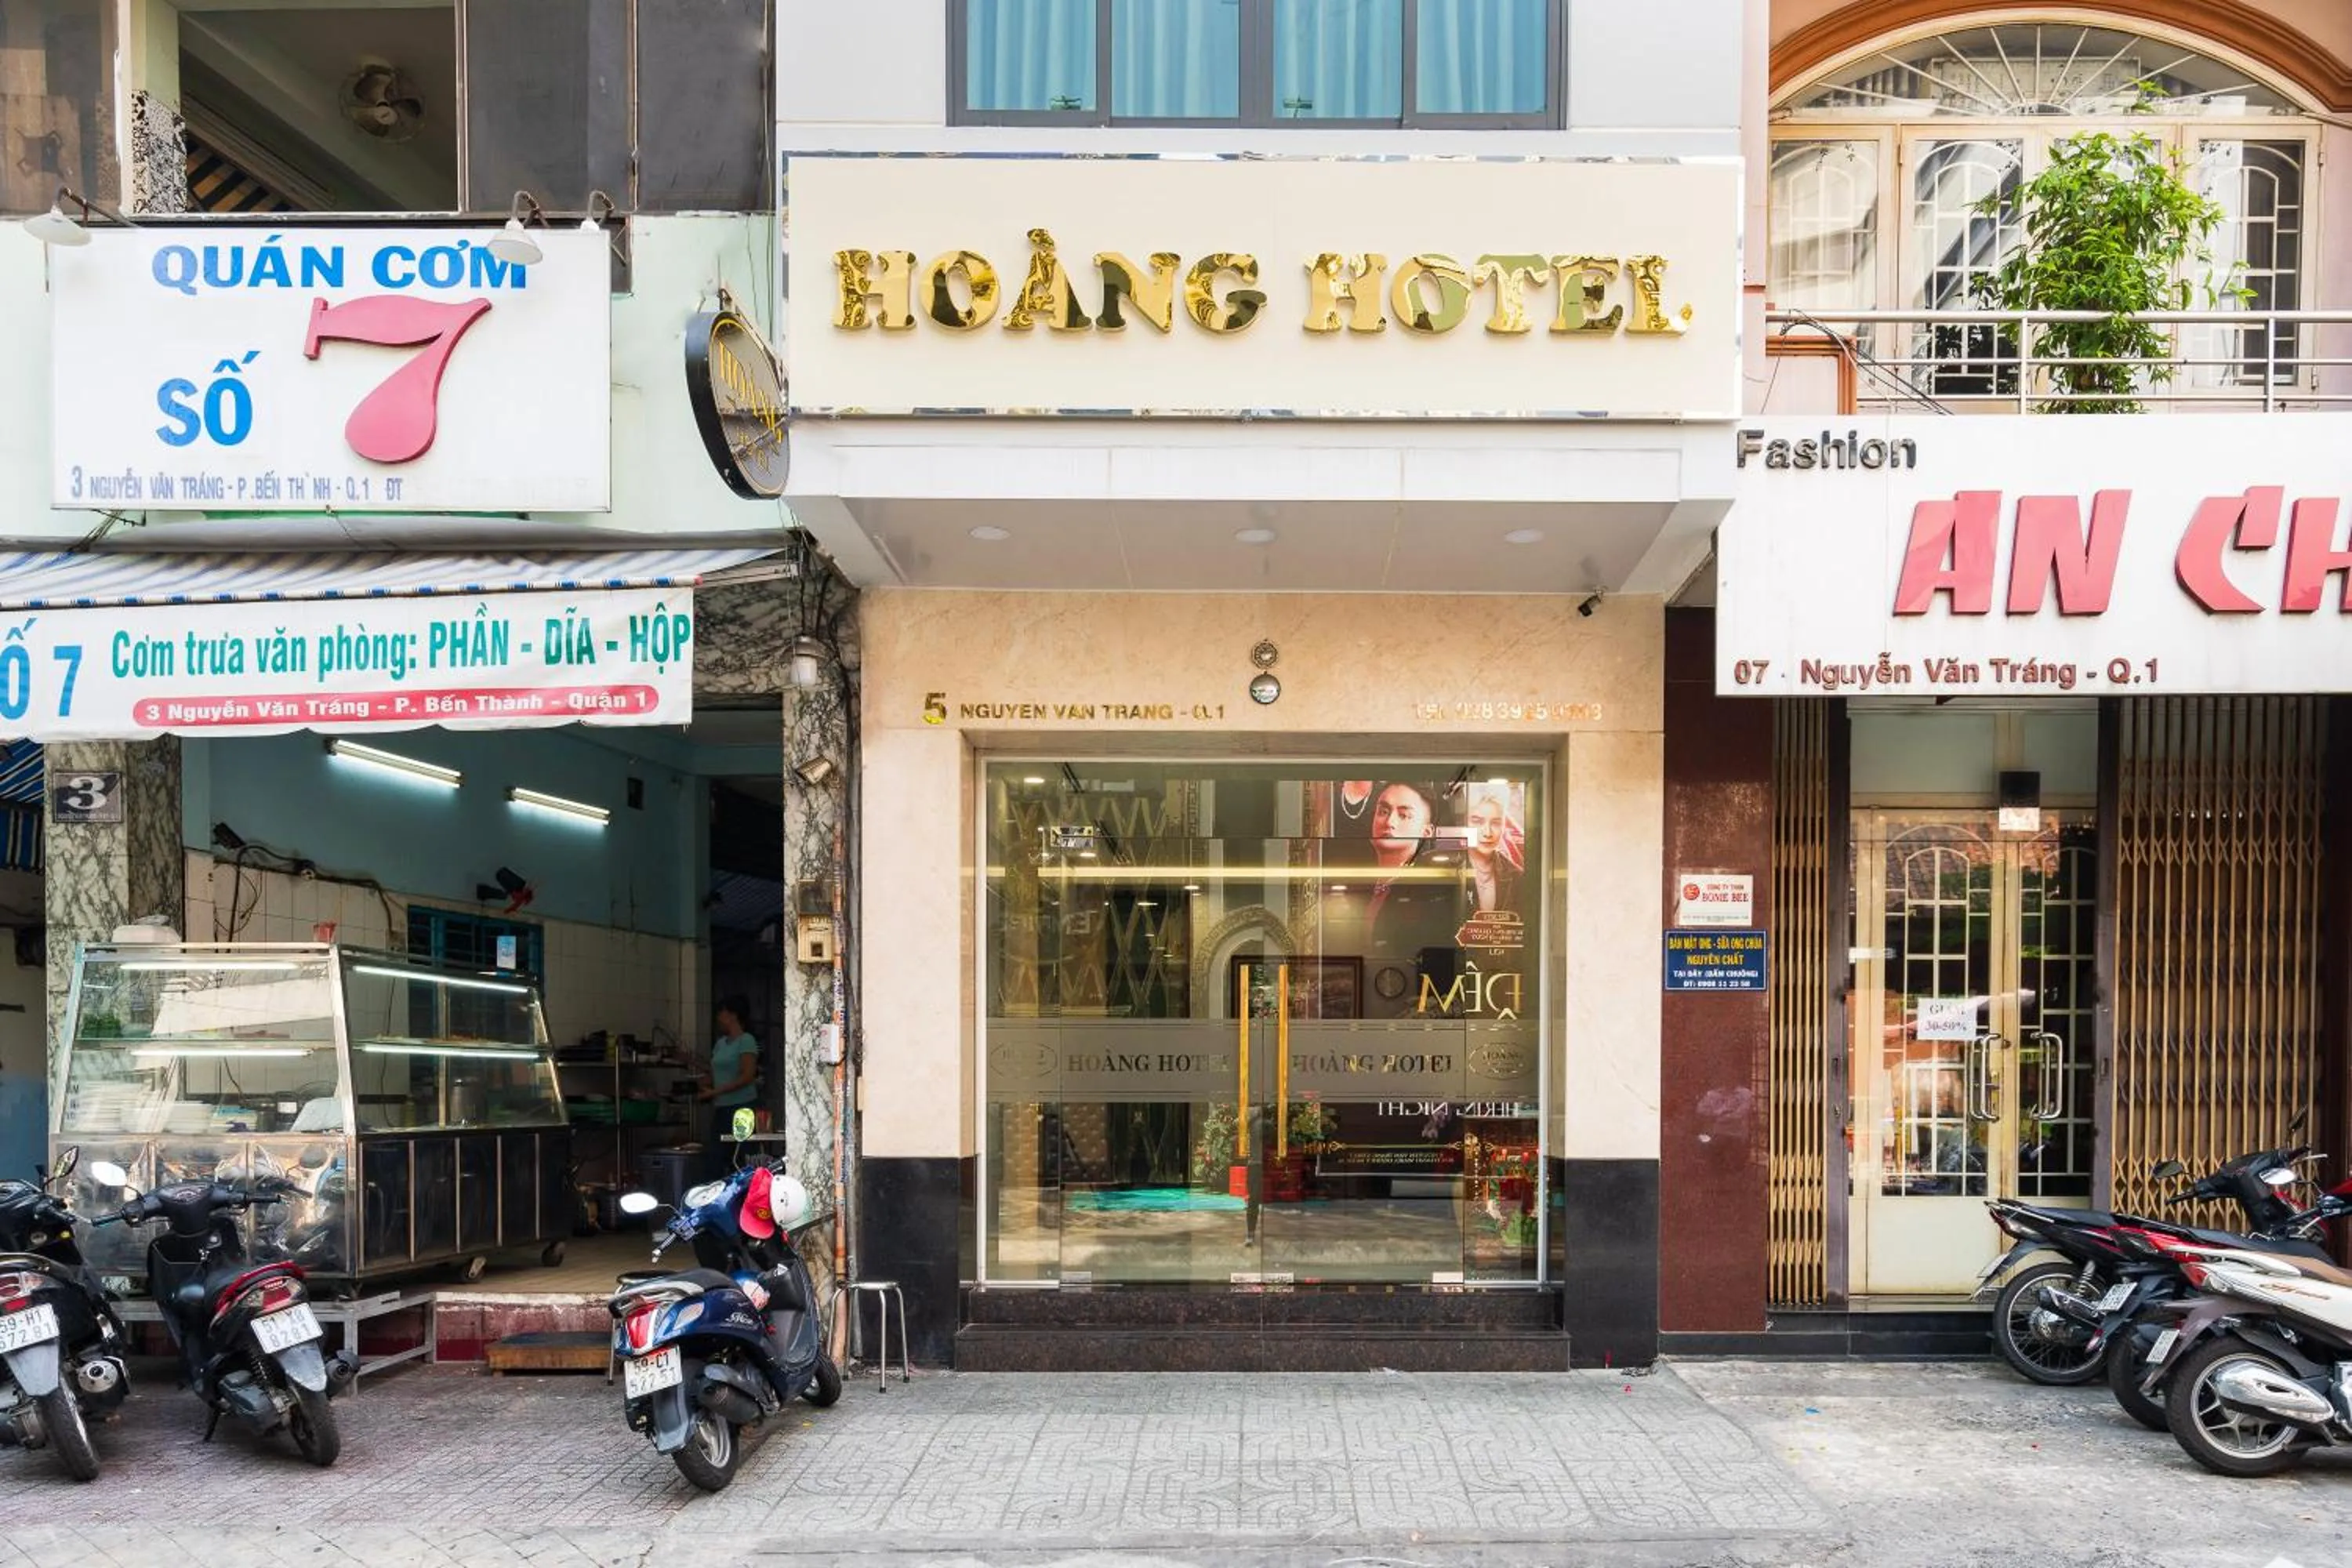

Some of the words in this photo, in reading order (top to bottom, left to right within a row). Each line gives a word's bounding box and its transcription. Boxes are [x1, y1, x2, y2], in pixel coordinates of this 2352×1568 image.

[151, 234, 345, 296] QUÁN
[372, 239, 527, 289] CƠM
[832, 227, 1268, 335] HOÀNG
[1302, 252, 1693, 338] HOTEL
[156, 350, 260, 447] SỐ
[303, 294, 492, 465] 7
[1735, 429, 1917, 470] Fashion
[71, 466, 82, 498] 3
[90, 467, 142, 499] NGUYỄN
[151, 471, 174, 500] VĂN
[182, 471, 225, 500] TRÁNG
[288, 472, 332, 500] THNH
[346, 477, 369, 501] Q.1
[1893, 489, 2132, 618] AN
[112, 630, 174, 678] Cơm
[185, 630, 244, 676] trưa
[255, 626, 307, 673] văn
[318, 622, 416, 682] phòng:
[428, 602, 510, 669] PHẦN
[629, 601, 691, 675] HỘP
[53, 645, 82, 717] 7
[1733, 659, 1770, 685] 07
[1800, 651, 1912, 691] Nguyễn
[1923, 656, 1980, 684] Văn
[1988, 656, 2078, 691] Tráng
[2107, 656, 2158, 685] Q.1
[146, 705, 161, 720] 3
[168, 699, 249, 722] Nguyễn
[257, 699, 299, 717] Văn
[306, 695, 370, 717] Tráng
[394, 697, 418, 713] P.
[426, 693, 469, 713] Bến
[475, 692, 543, 711] Thành
[568, 691, 627, 713] Quận
[634, 691, 648, 707] 1
[923, 691, 948, 725] 5
[959, 703, 1047, 720] NGUYEN
[1053, 704, 1096, 720] VAN
[1102, 704, 1174, 720] TRANG
[63, 775, 108, 811] 3
[1067, 1047, 1149, 1073] HOÀNG
